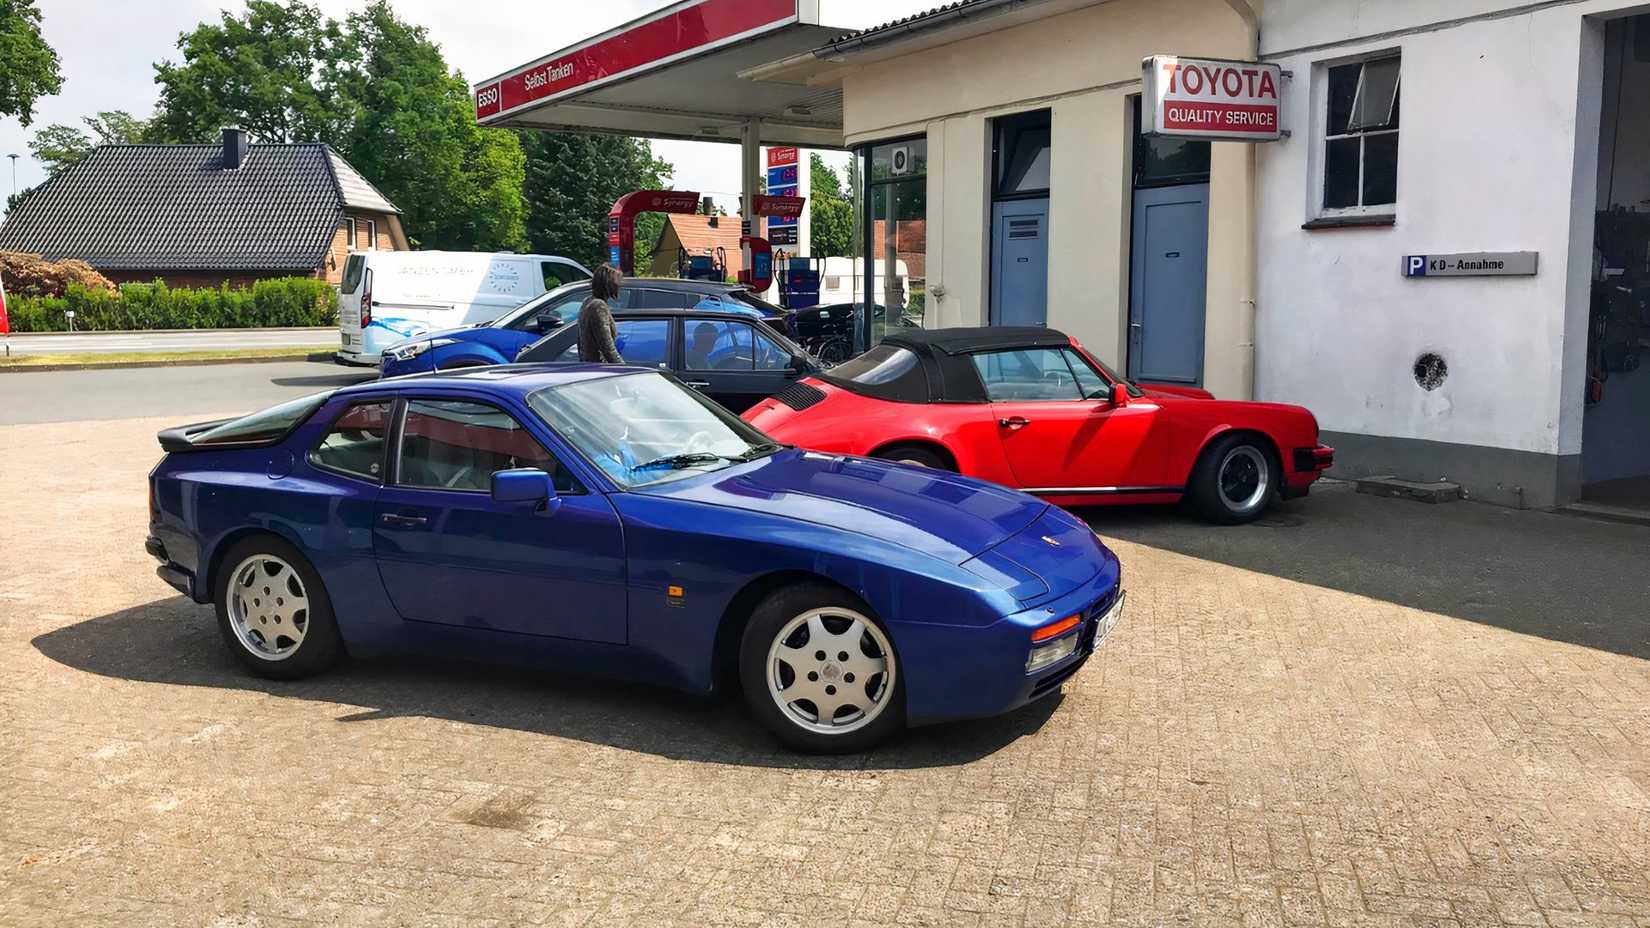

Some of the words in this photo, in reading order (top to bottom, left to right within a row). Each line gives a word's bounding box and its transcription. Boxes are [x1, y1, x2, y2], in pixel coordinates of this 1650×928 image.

[524, 71, 547, 91] Selbst
[547, 62, 574, 83] Tanken
[1162, 64, 1277, 99] TOYOTA
[1168, 107, 1222, 123] QUALITY
[1225, 110, 1273, 126] SERVICE
[1409, 256, 1423, 275] P
